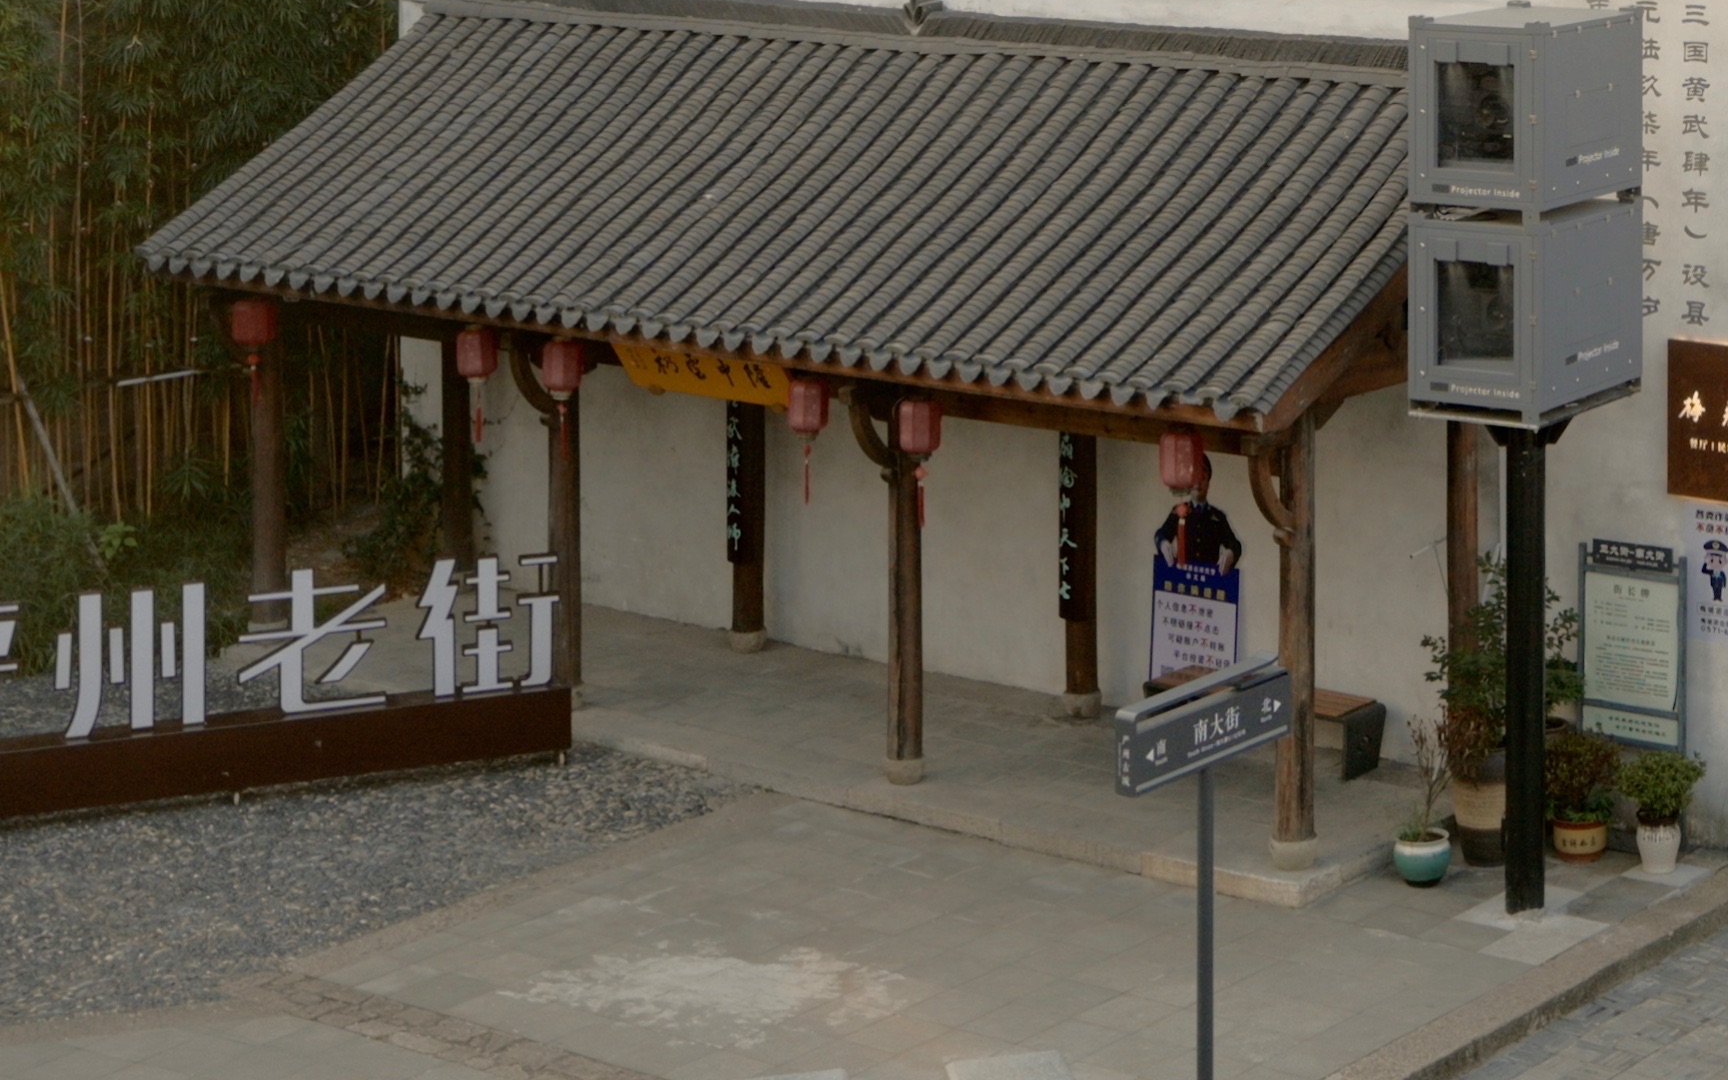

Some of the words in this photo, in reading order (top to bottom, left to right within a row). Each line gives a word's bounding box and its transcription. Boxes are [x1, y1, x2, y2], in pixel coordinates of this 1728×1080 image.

[1451, 185, 1491, 197] Projector
[1451, 383, 1491, 395] Projector
[0, 553, 561, 739] 州老街
[1260, 697, 1272, 714] 北
[1193, 706, 1241, 746] 南大街
[1156, 738, 1167, 756] 南
